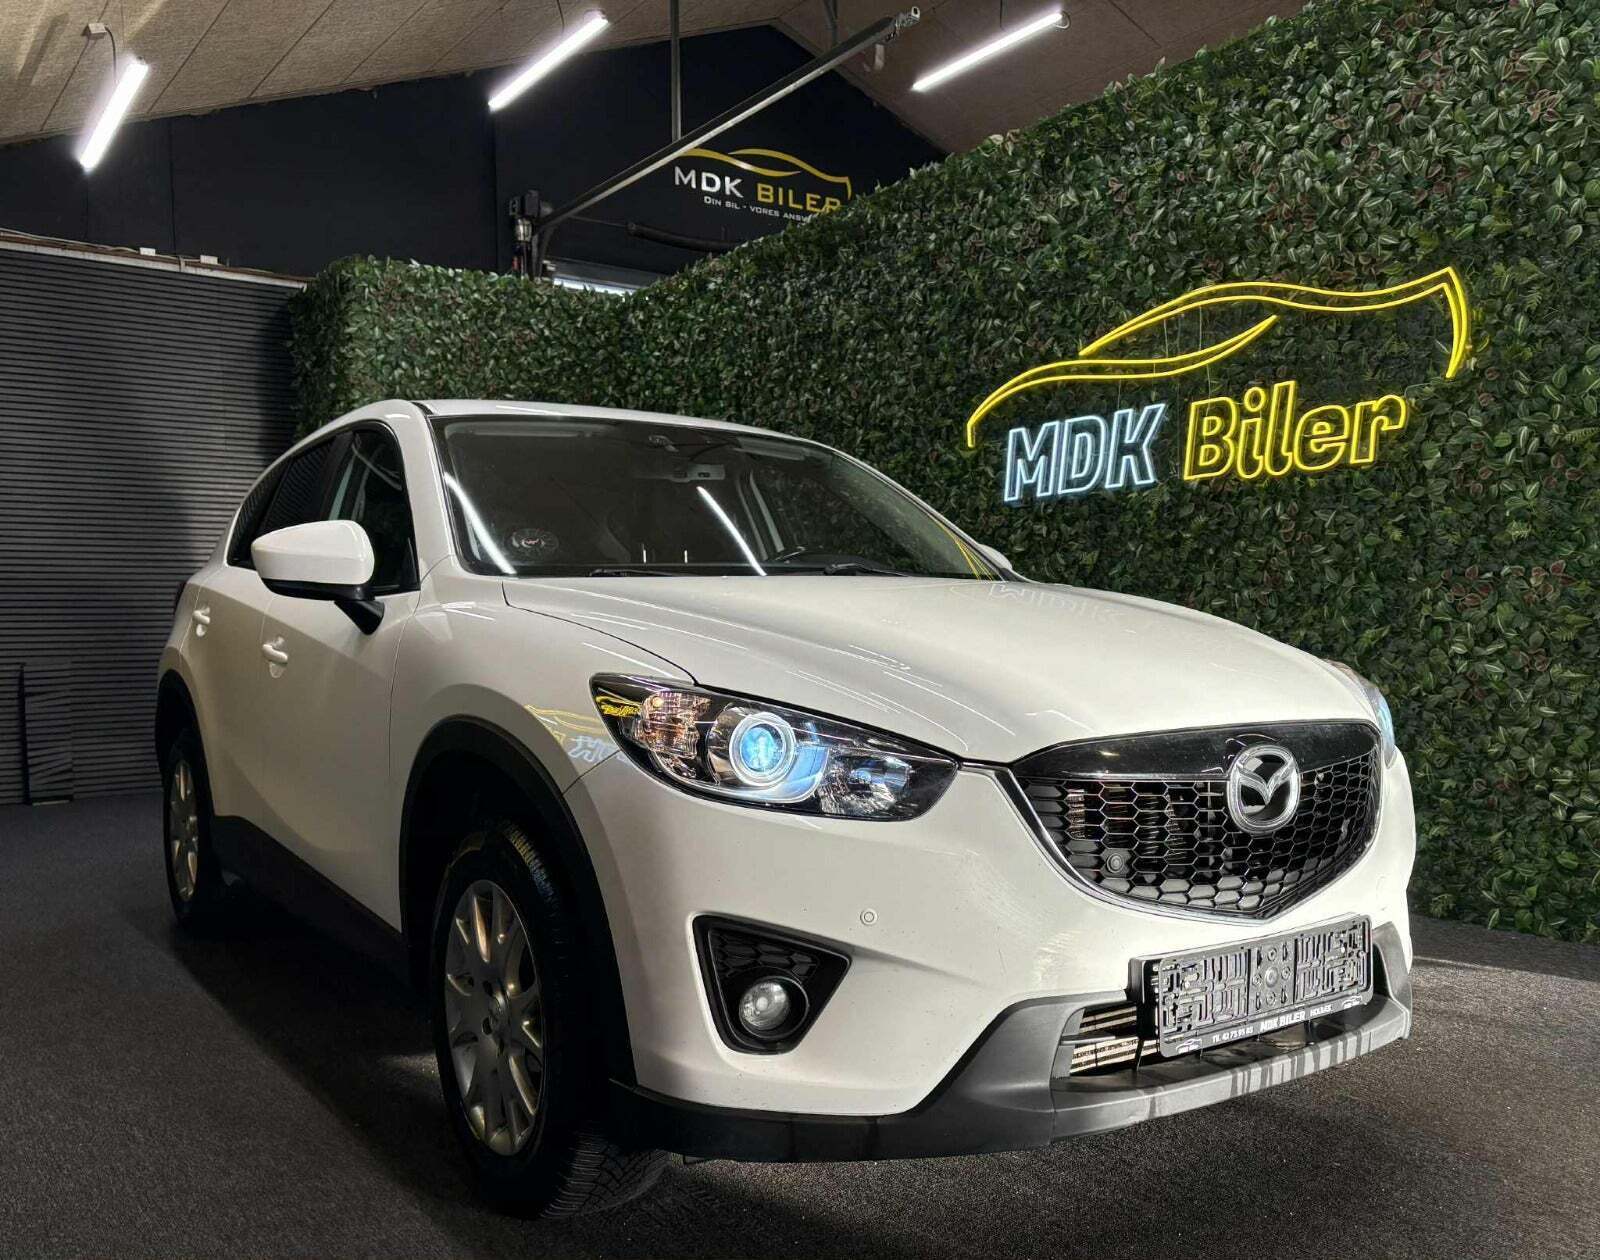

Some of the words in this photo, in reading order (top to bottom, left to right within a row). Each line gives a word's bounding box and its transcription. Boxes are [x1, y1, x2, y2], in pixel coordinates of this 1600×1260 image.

[674, 166, 744, 199] MDK
[756, 182, 842, 214] BILER
[749, 205, 780, 217] VORES
[1003, 402, 1167, 502] MDK
[1182, 379, 1408, 482] Biler
